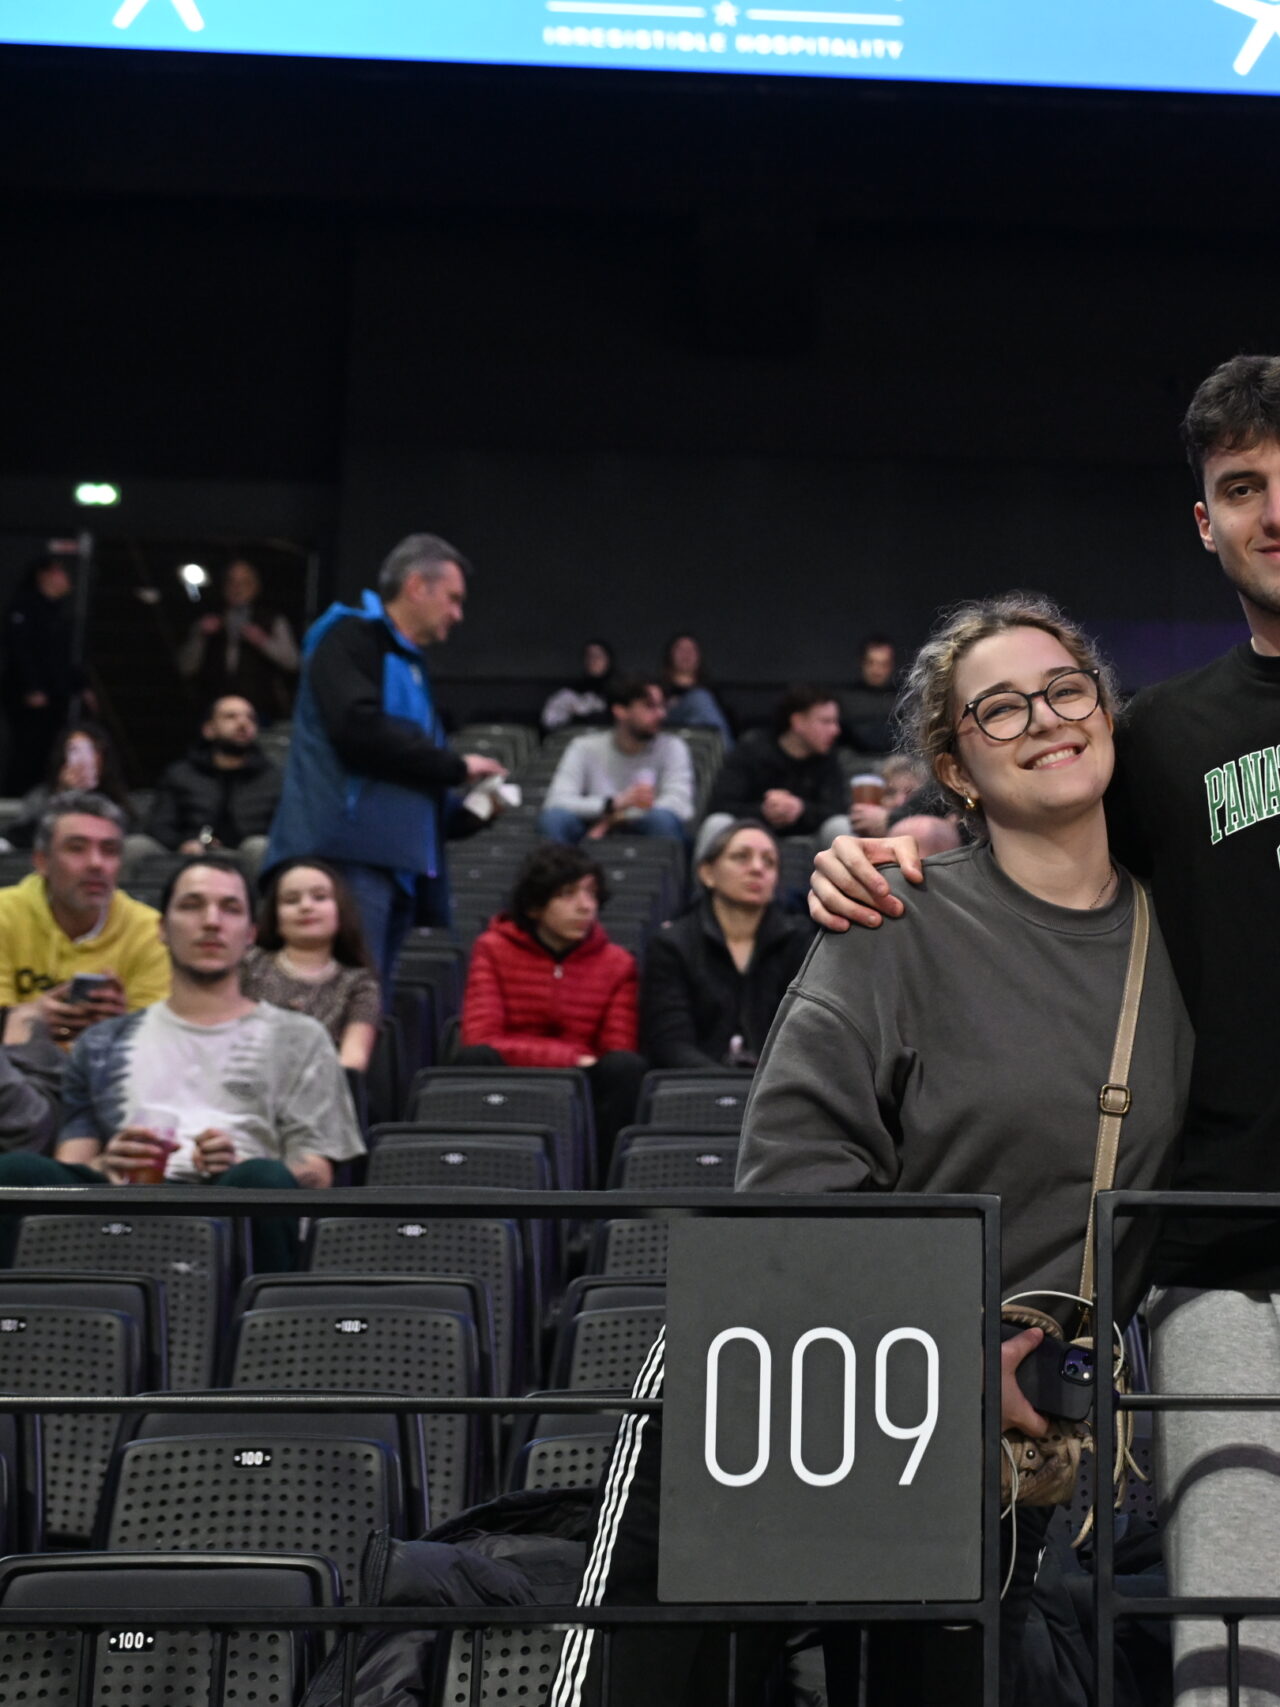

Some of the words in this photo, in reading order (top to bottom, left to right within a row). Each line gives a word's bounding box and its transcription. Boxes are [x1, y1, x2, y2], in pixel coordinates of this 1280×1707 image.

[735, 34, 903, 59] HOSPITALITY
[705, 1327, 939, 1487] 009
[240, 1451, 264, 1465] 100
[119, 1631, 144, 1649] 100
